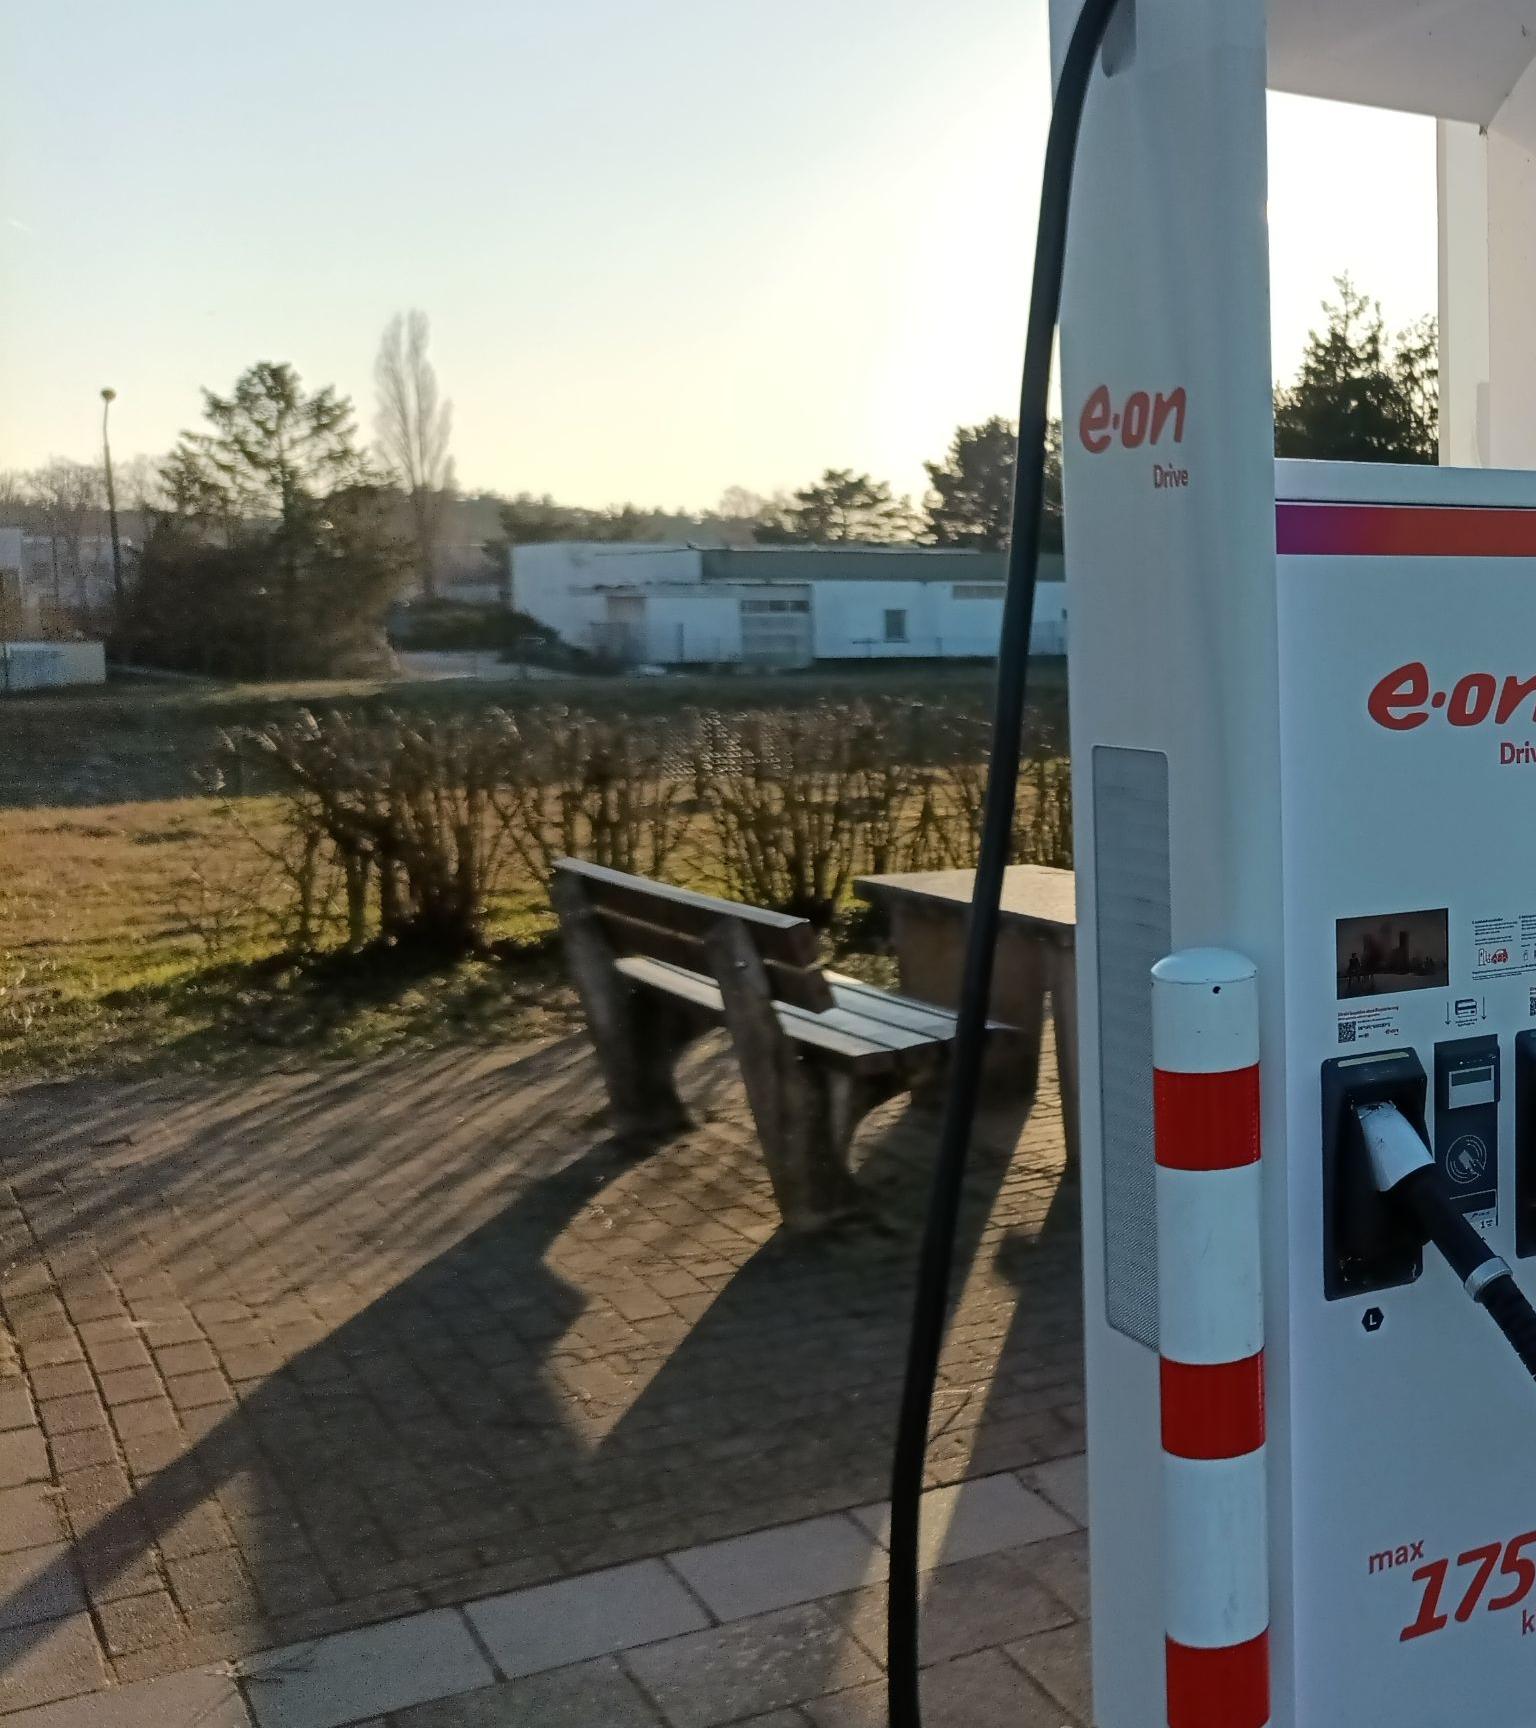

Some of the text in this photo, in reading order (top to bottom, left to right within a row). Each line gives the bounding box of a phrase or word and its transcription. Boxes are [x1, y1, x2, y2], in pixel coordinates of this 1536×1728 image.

[1154, 462, 1189, 488] Drive
[1369, 1314, 1378, 1326] L
[1368, 1540, 1424, 1575] max
